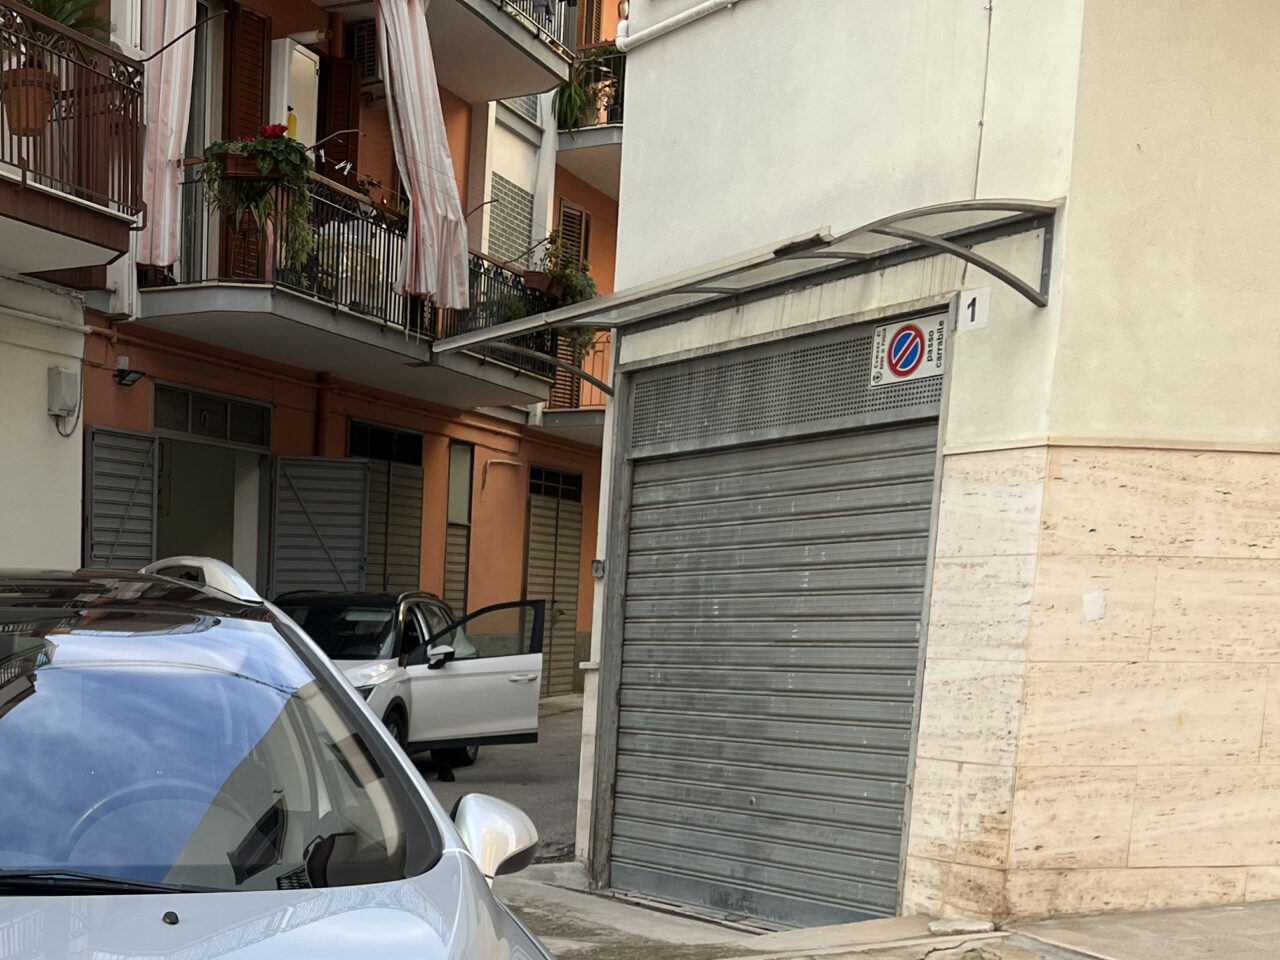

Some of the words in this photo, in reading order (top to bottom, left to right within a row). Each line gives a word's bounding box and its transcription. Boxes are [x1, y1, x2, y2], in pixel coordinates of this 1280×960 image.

[967, 297, 977, 322] 1
[926, 330, 935, 362] passo
[935, 320, 945, 368] carrabile
